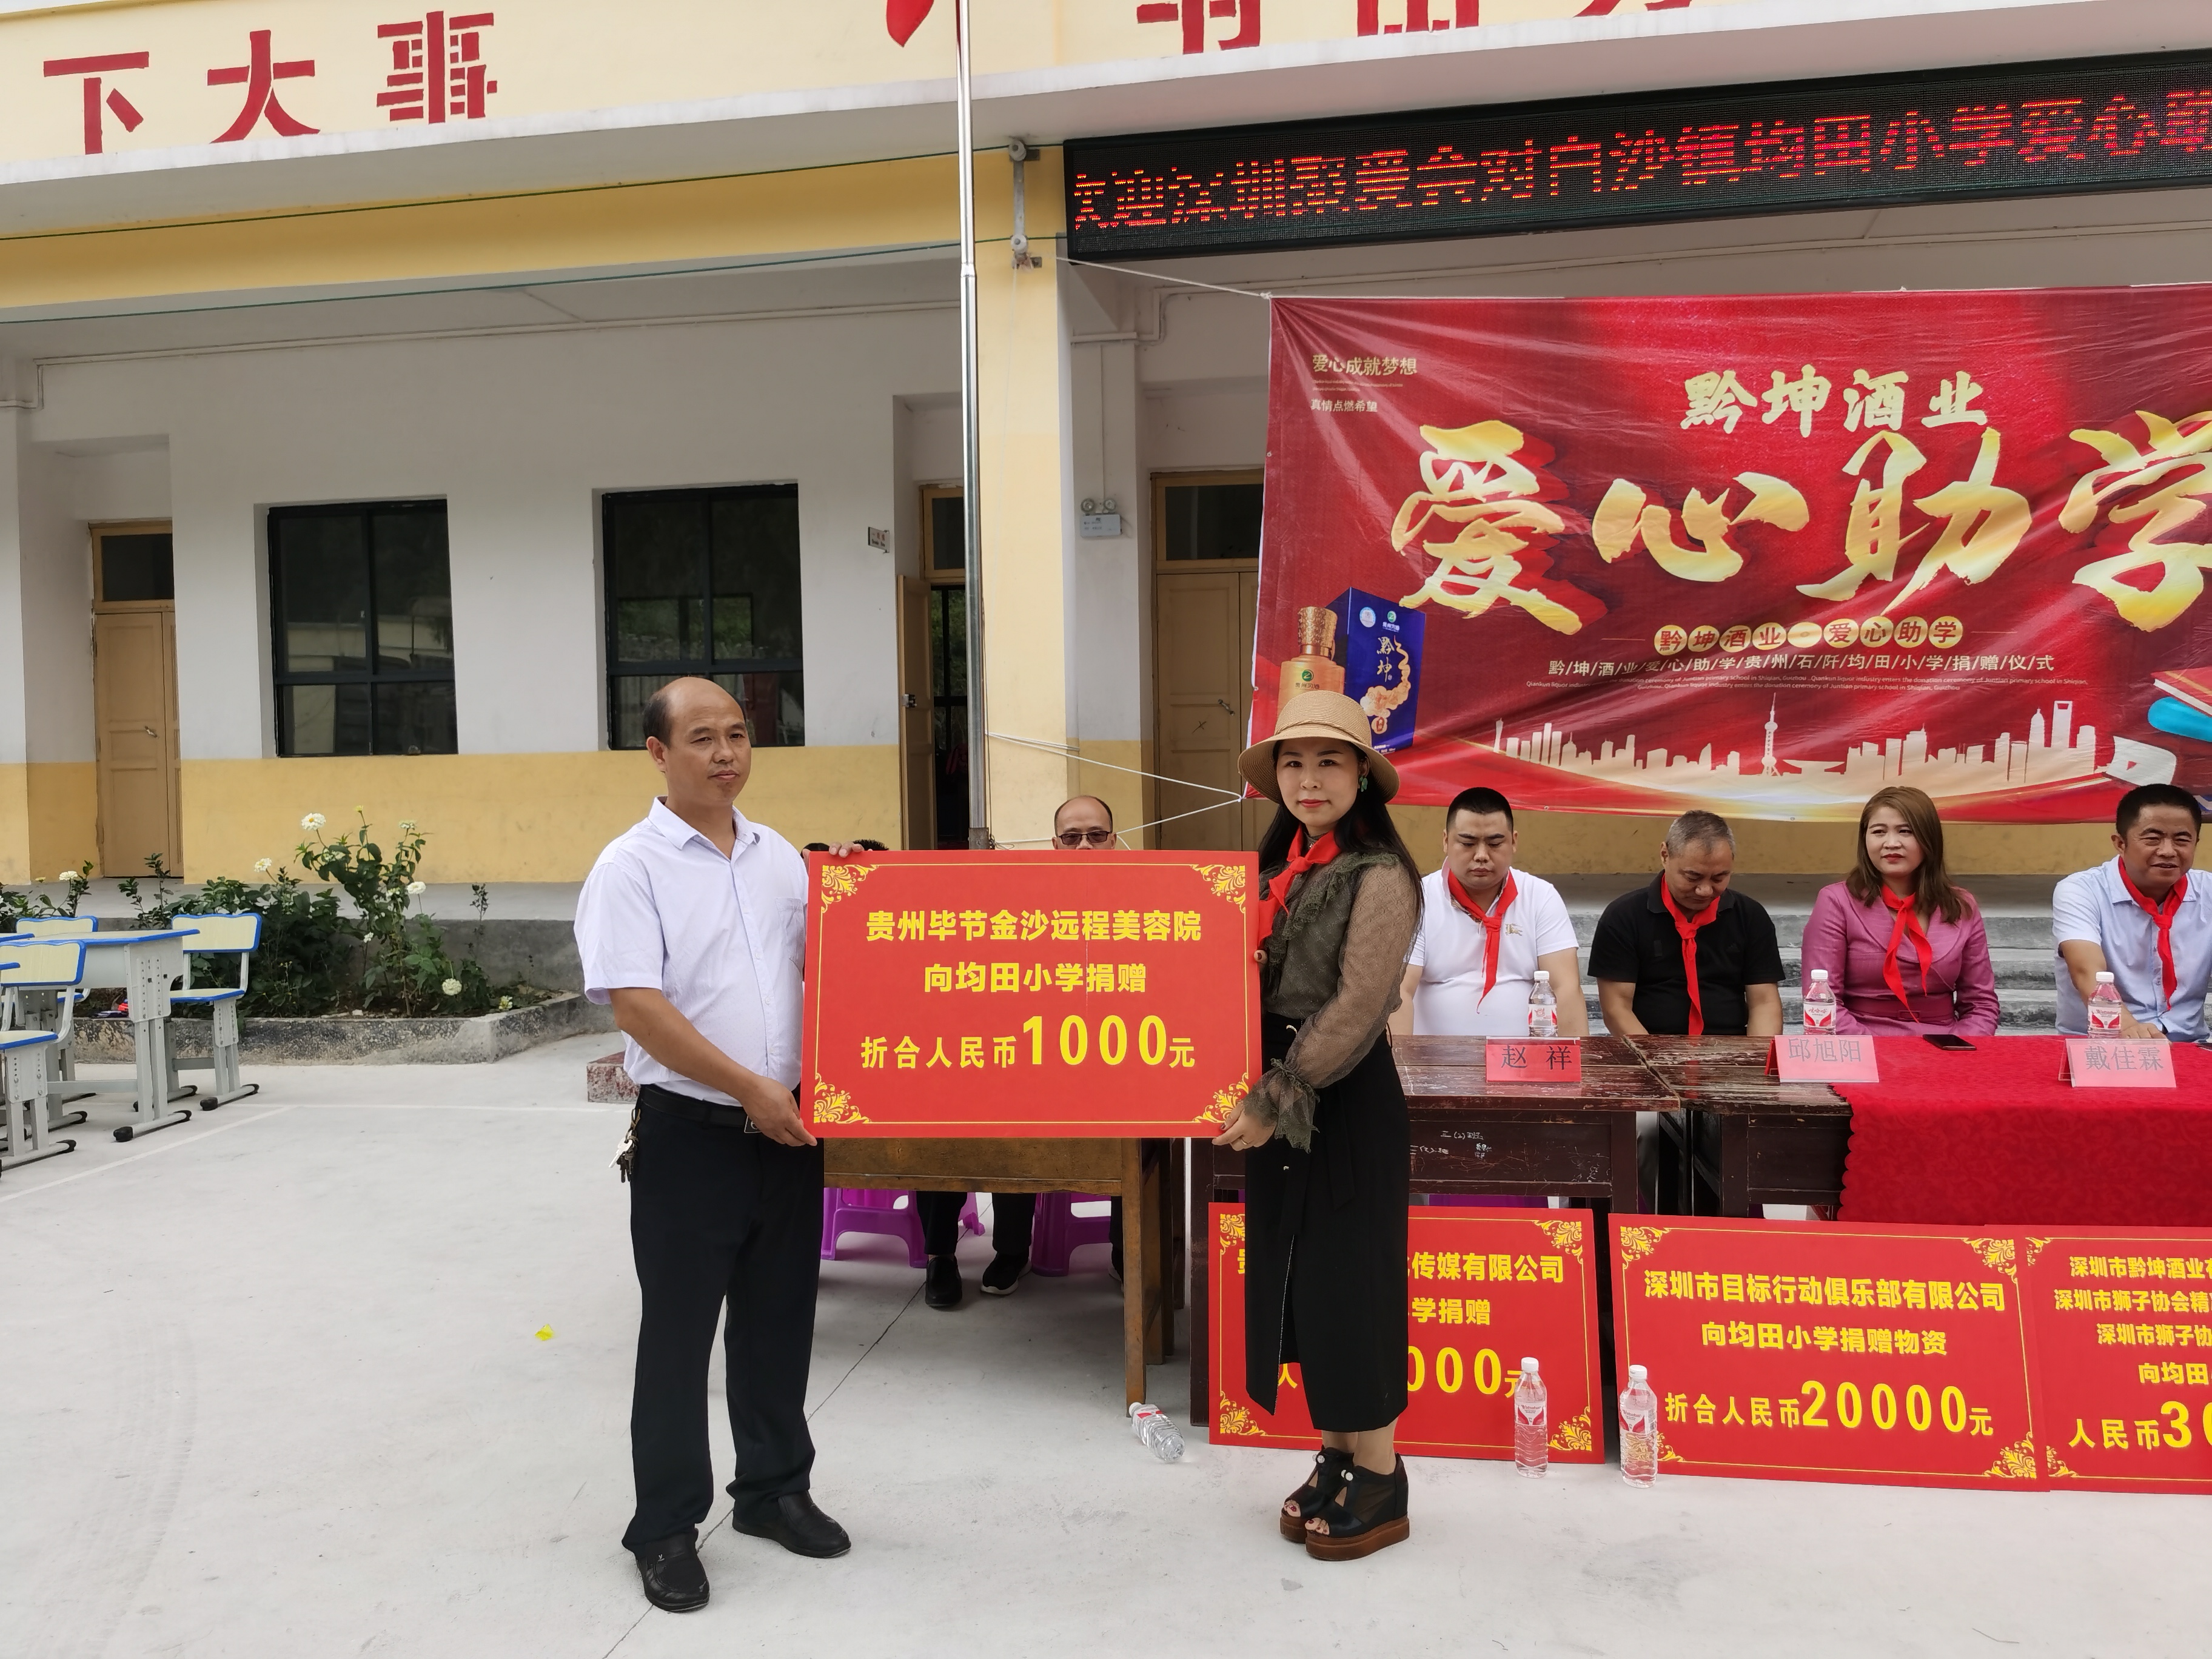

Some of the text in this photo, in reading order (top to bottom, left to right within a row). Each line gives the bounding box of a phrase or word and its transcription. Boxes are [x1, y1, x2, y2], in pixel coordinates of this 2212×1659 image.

[1312, 354, 1418, 376] 爱心成就梦想
[1311, 398, 1378, 412] 真情点燃希望
[1681, 364, 1988, 437] 黔坤酒业
[1391, 410, 2212, 635] 爱心助学
[866, 909, 1201, 942] 贵州毕节金沙远程美容院
[924, 961, 1147, 993] 向均田小学捐赠
[1788, 1037, 1862, 1062] 邱旭阳
[2084, 1045, 2164, 1071] 戴佳霖
[1408, 1252, 1564, 1283] 传媒有限公司
[1644, 1269, 2006, 1312] 深圳市目标行动俱乐部有限公司
[2054, 1289, 2212, 1313] 深圳市狮子协会精
[1410, 1297, 1491, 1326] 学捐赠
[1701, 1321, 1948, 1356] 向均田小学捐赠物资
[2096, 1323, 2212, 1347] 深圳市狮子协
[2138, 1361, 2212, 1385] 向均田
